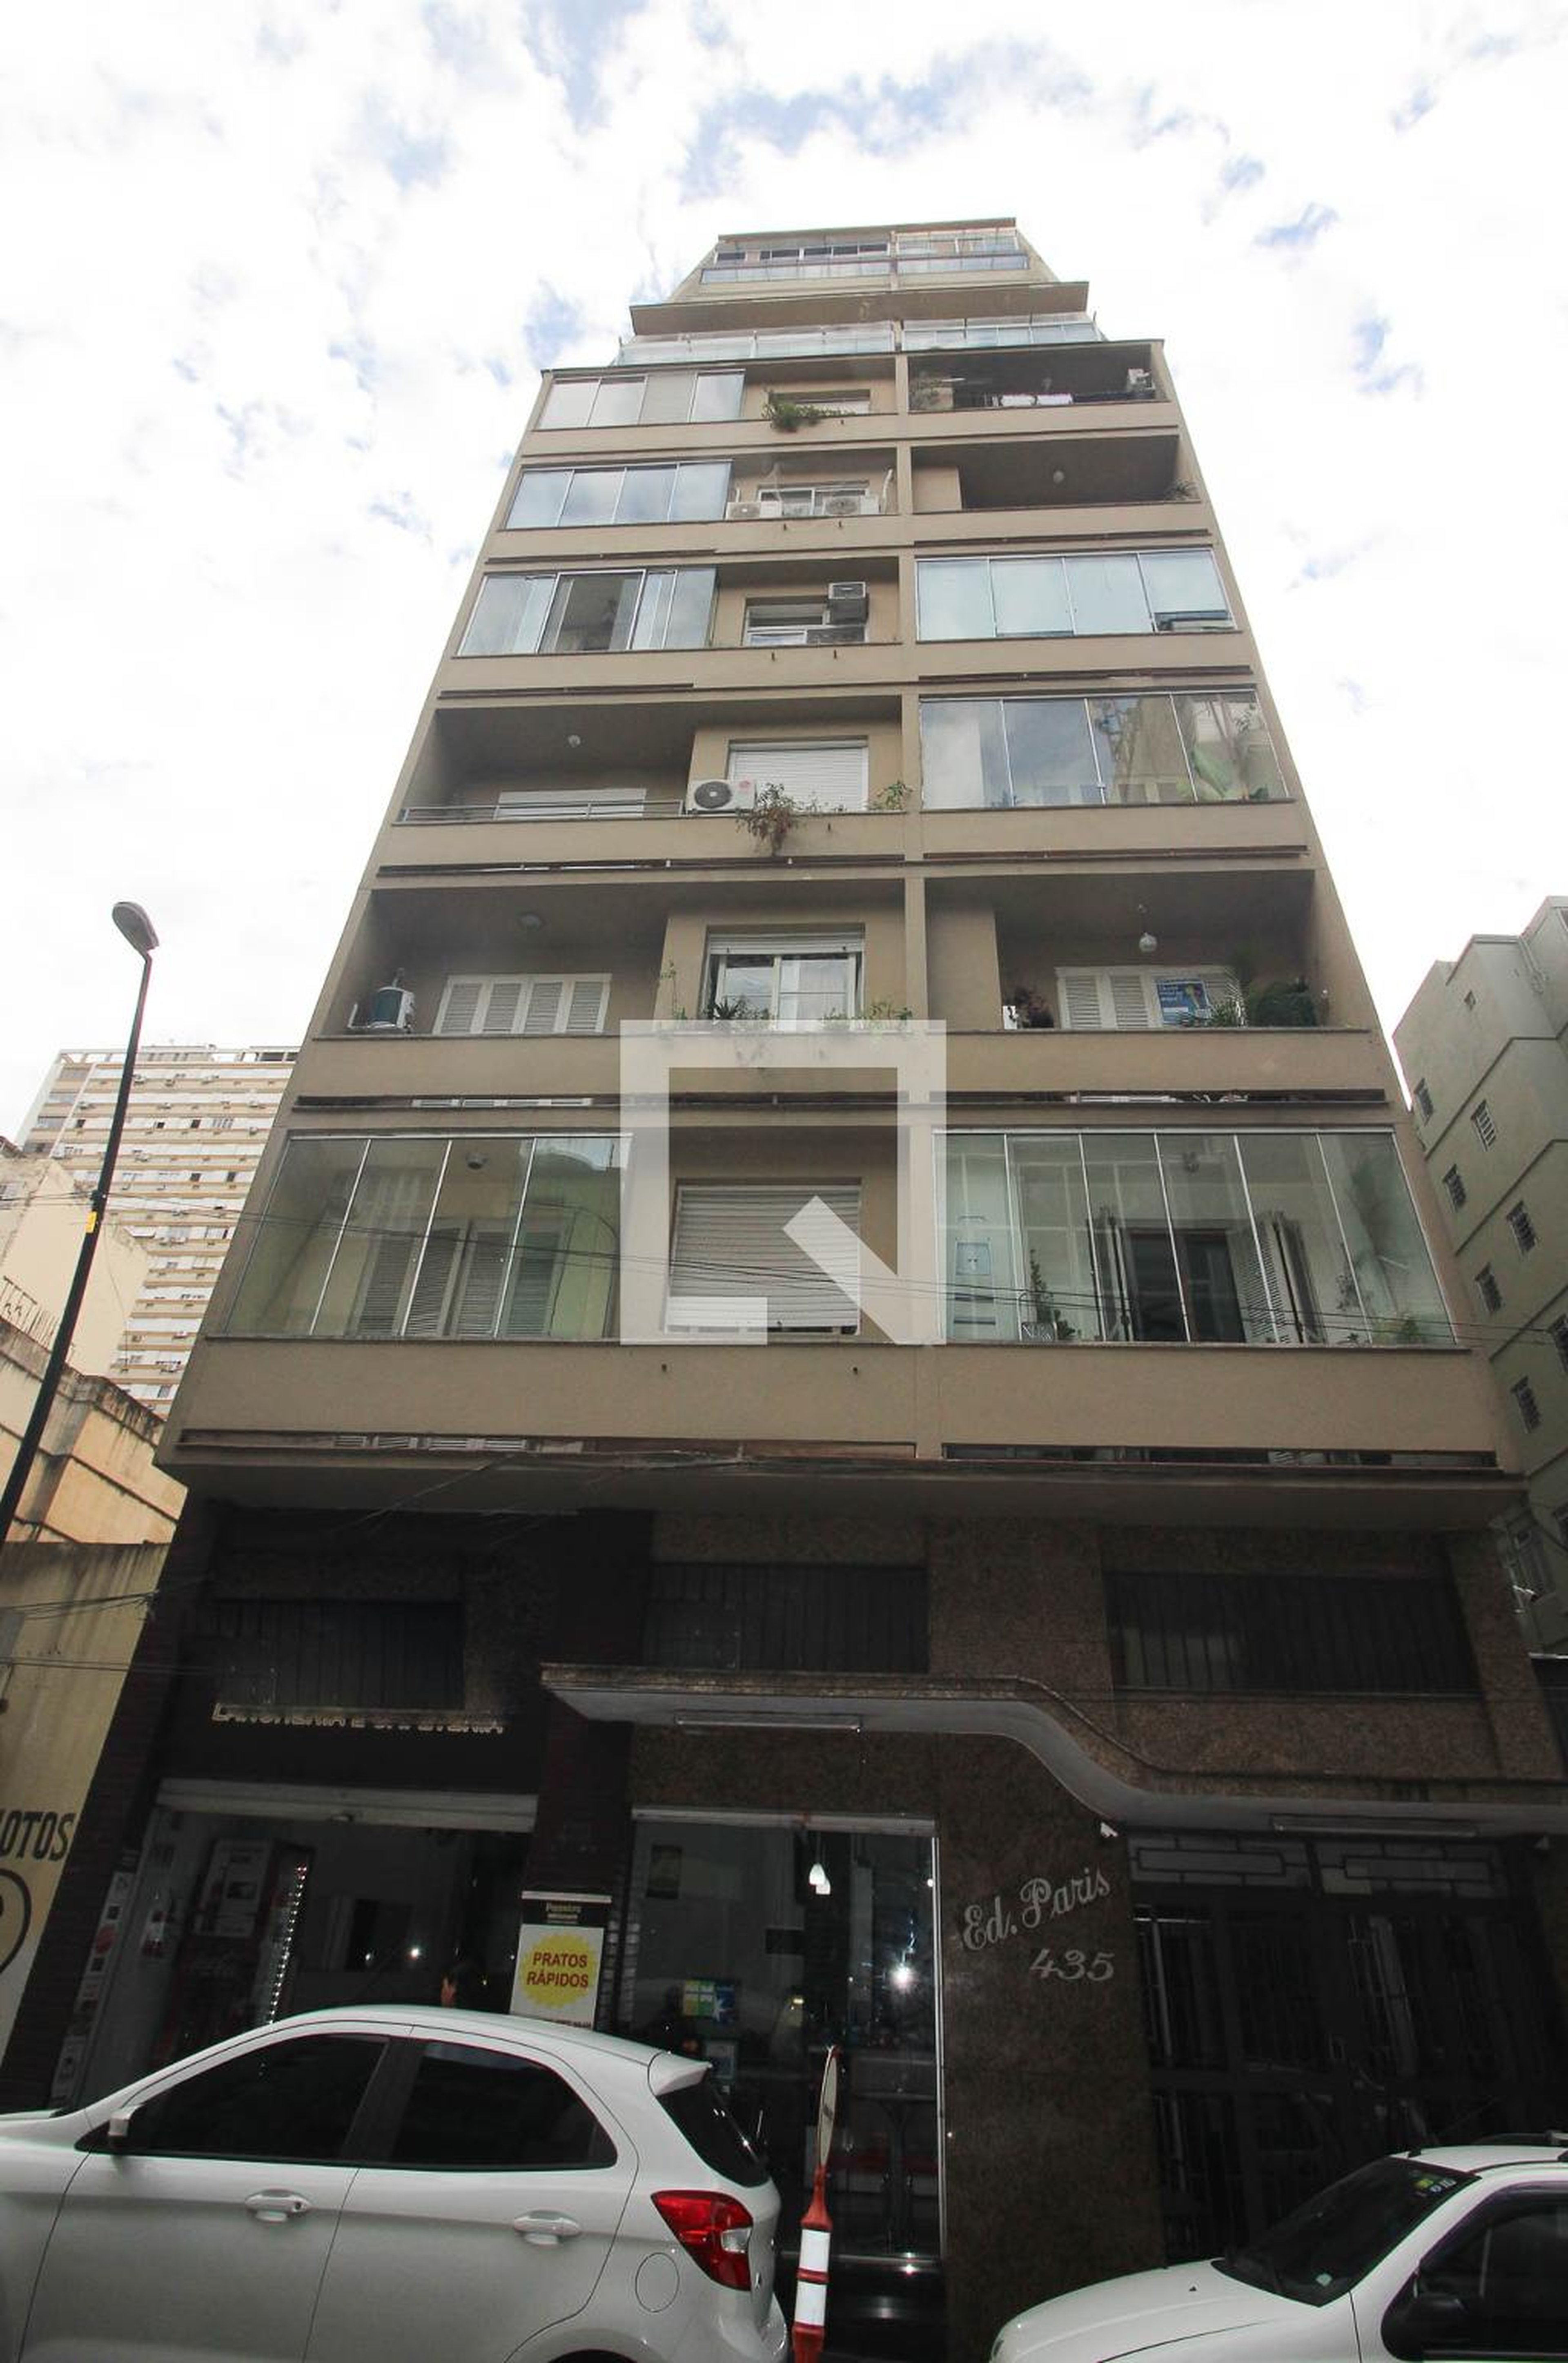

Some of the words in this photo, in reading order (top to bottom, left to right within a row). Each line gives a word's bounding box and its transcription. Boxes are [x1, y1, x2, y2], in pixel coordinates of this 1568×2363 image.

[0, 1810, 77, 1861] OTOS
[963, 1896, 1018, 1950] Ed.
[1020, 1867, 1111, 1928] Paris
[532, 1951, 588, 1968] PRATOS
[1029, 1948, 1115, 1981] 435
[526, 1970, 589, 1988] RÁPIDOS
